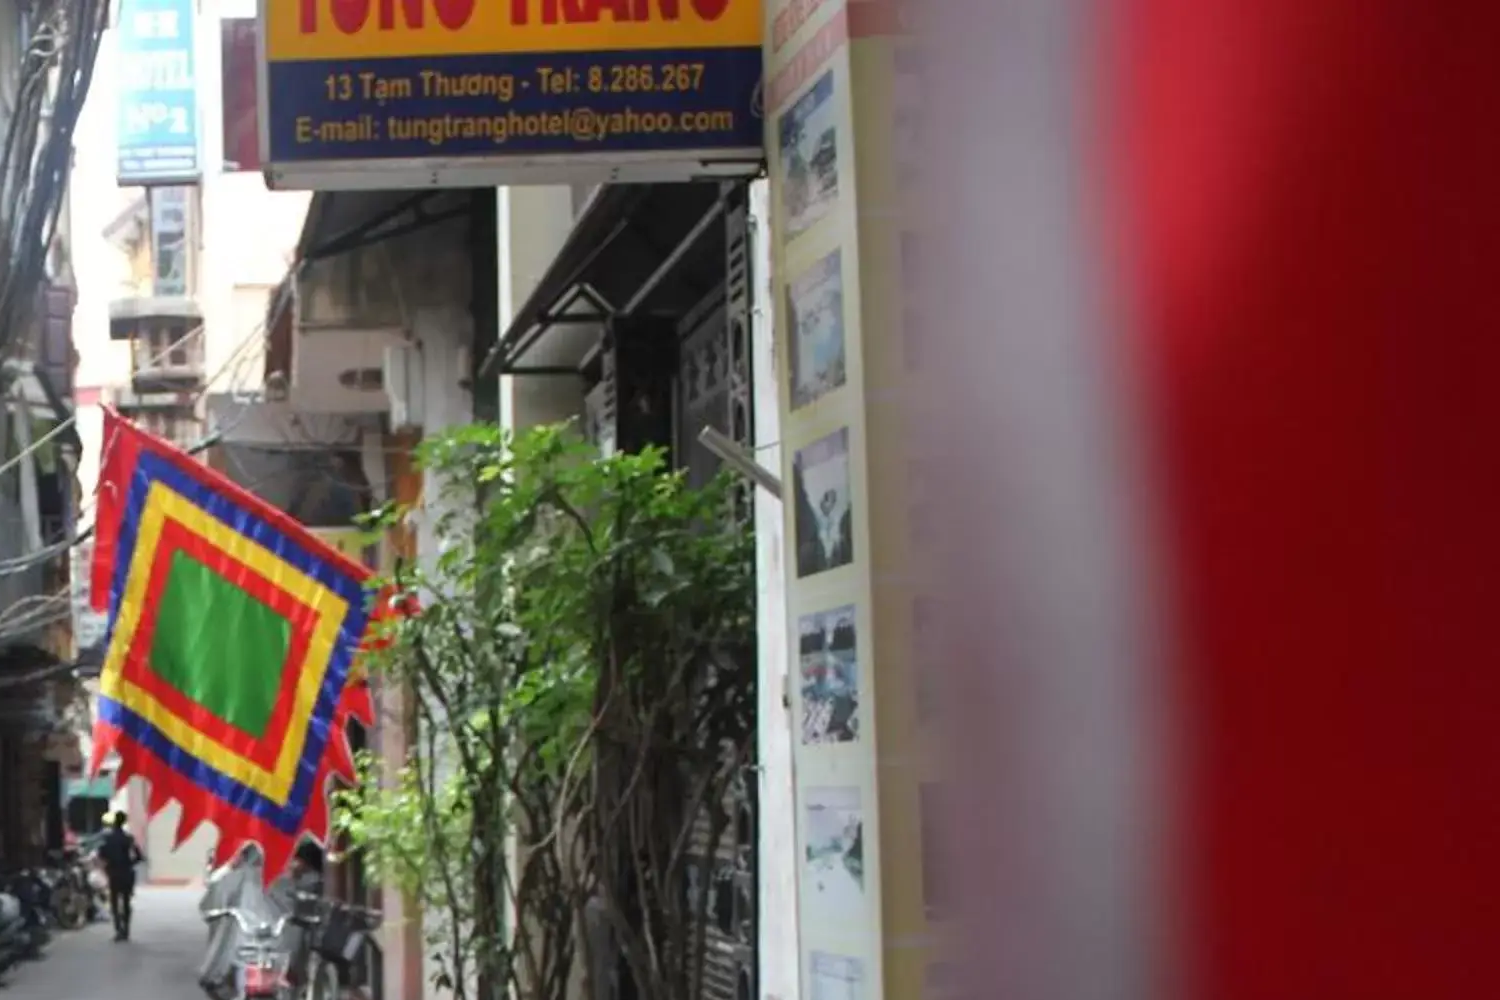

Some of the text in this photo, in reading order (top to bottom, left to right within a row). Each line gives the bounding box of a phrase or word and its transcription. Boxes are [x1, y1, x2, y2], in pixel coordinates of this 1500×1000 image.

[325, 73, 352, 100] 13
[359, 72, 411, 106] Tạm
[536, 66, 581, 95] Tel:
[587, 64, 705, 94] 8.286.267
[295, 105, 734, 146] E-mail: tungtranghotel@yahoo.com
